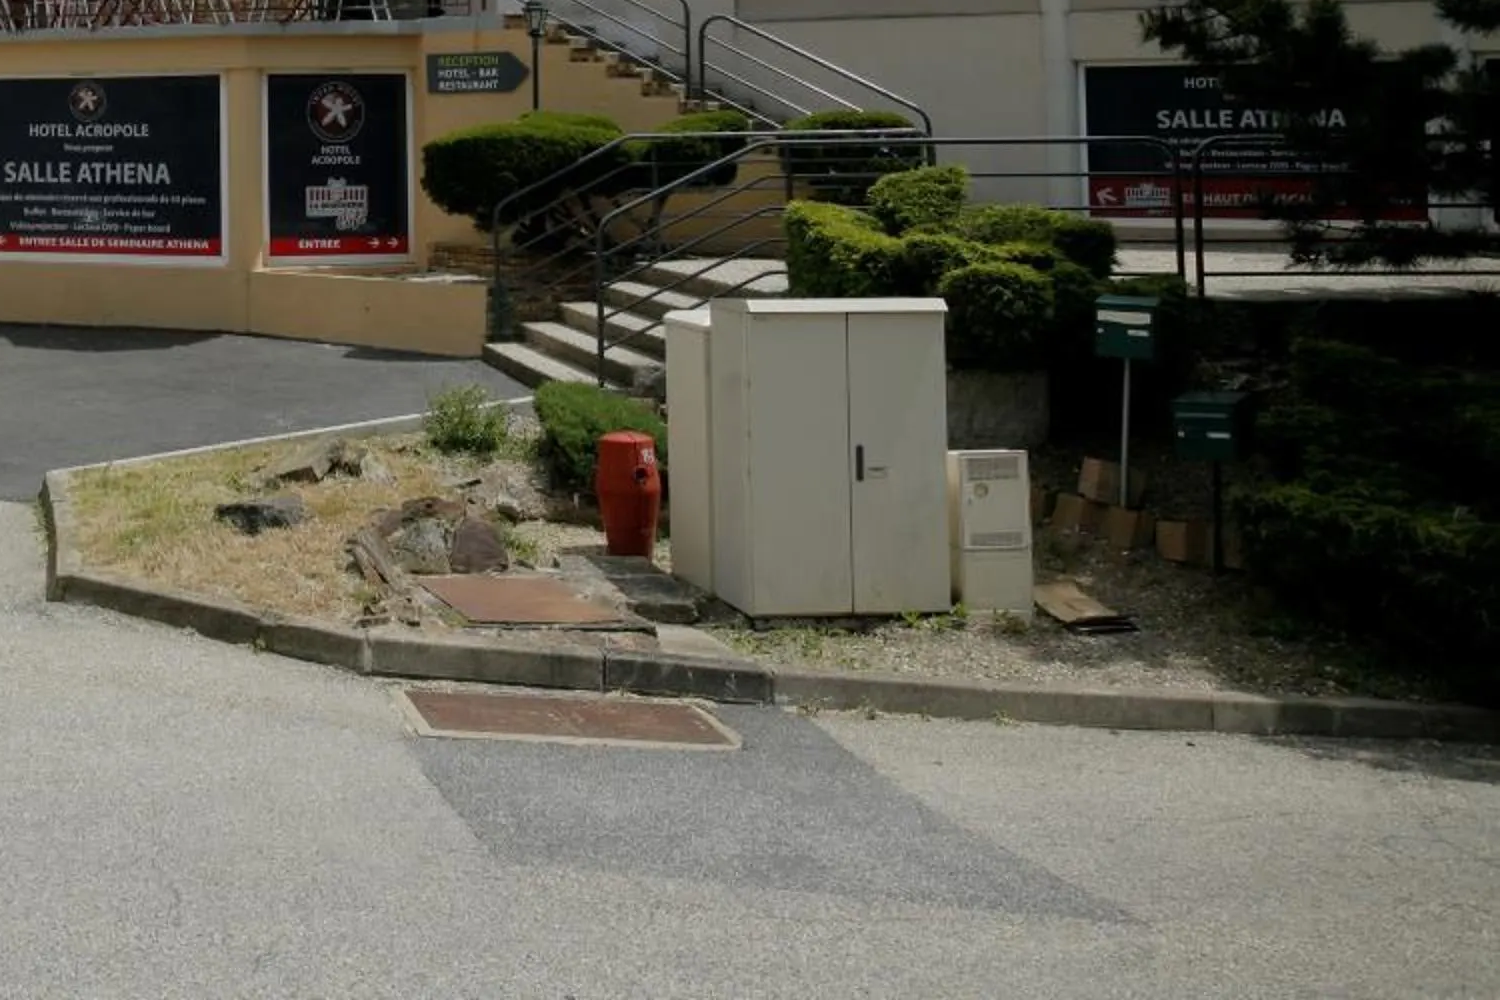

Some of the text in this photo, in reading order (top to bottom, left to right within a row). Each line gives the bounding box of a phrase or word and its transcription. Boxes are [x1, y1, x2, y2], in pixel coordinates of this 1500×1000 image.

[437, 55, 500, 67] RECEPTION
[437, 67, 500, 79] HOTEL BAR
[437, 80, 499, 91] RESTAURANT
[1156, 109, 1234, 130] SALLE
[29, 123, 150, 138] HOTEL ACROPOLE
[320, 145, 351, 156] HOTEL
[311, 155, 362, 166] ACROPOLE
[4, 161, 171, 185] SALLE ATHENA
[166, 238, 210, 250] ATHENA
